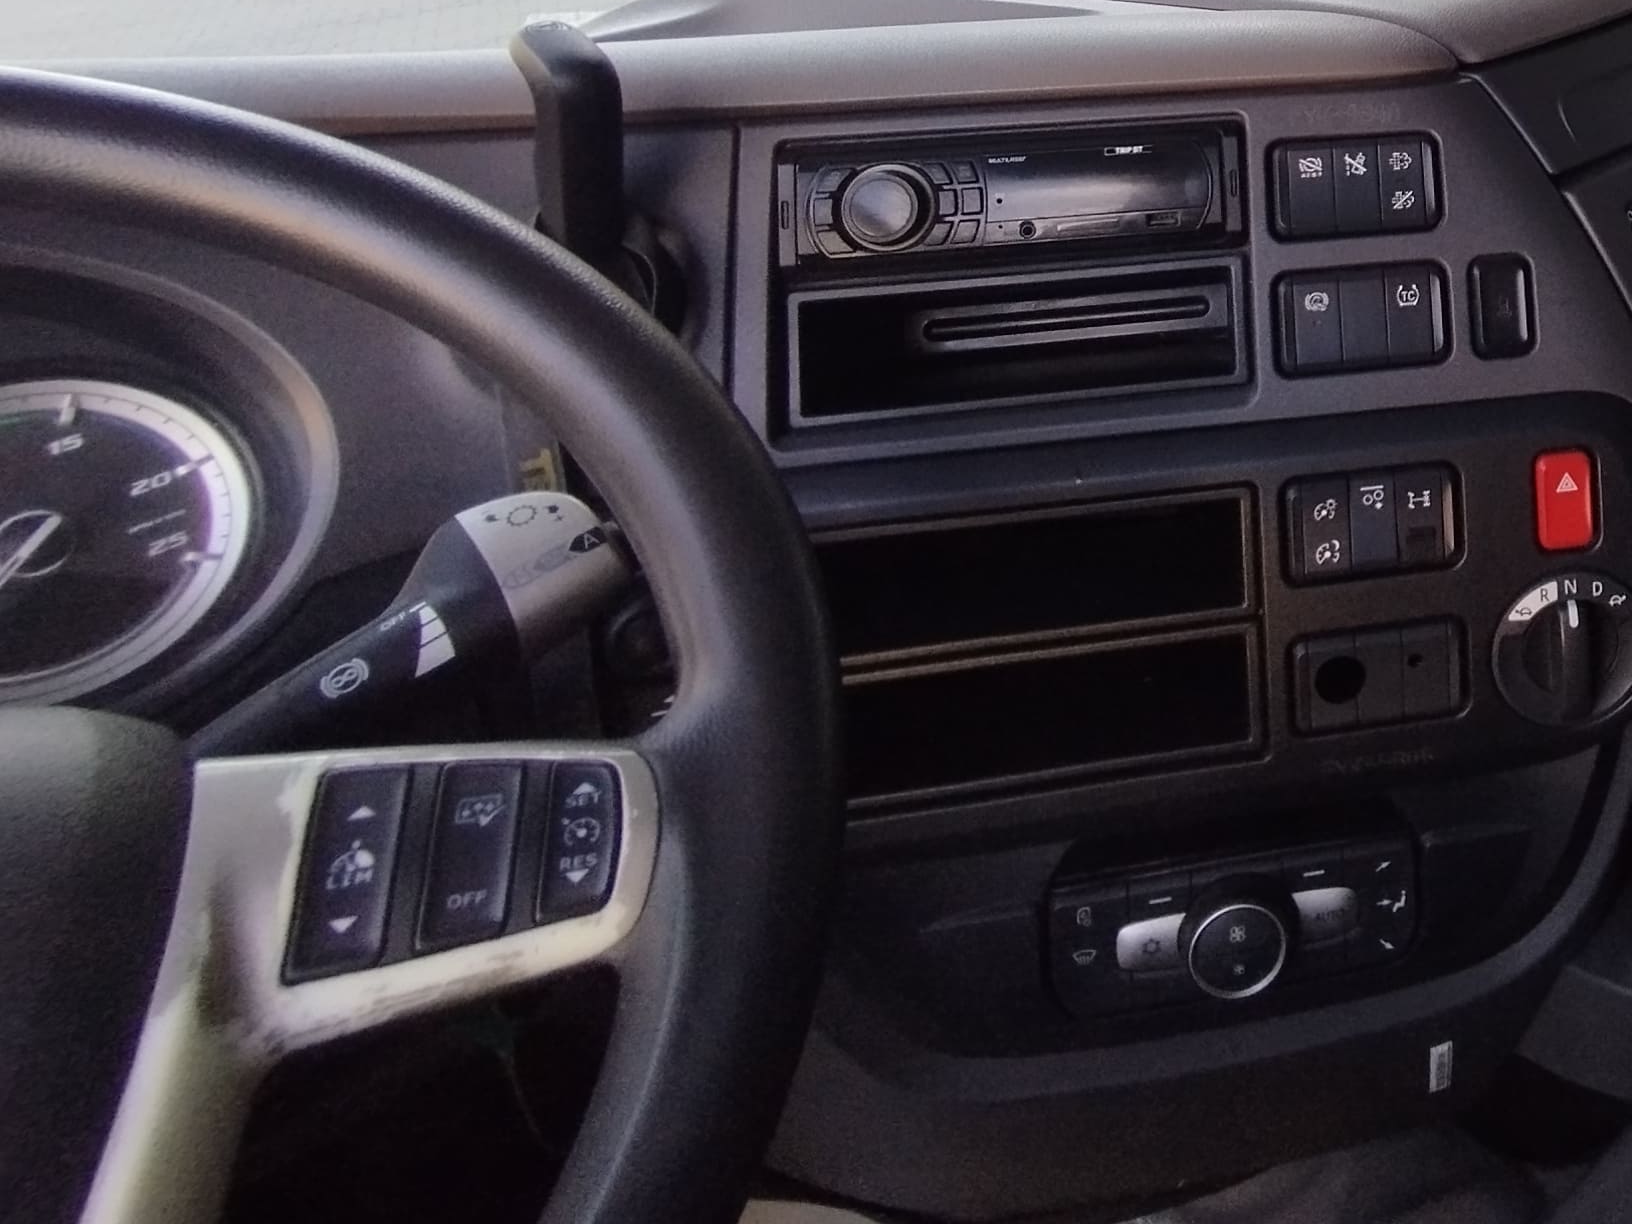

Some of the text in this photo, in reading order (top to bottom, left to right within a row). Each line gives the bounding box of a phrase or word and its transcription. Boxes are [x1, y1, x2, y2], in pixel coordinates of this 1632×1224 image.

[48, 432, 84, 456] 15
[129, 470, 172, 497] 20
[148, 529, 190, 558] 25
[1540, 579, 1604, 603] R N D
[559, 852, 599, 871] RES
[325, 868, 374, 891] LIM
[446, 888, 488, 911] OFF
